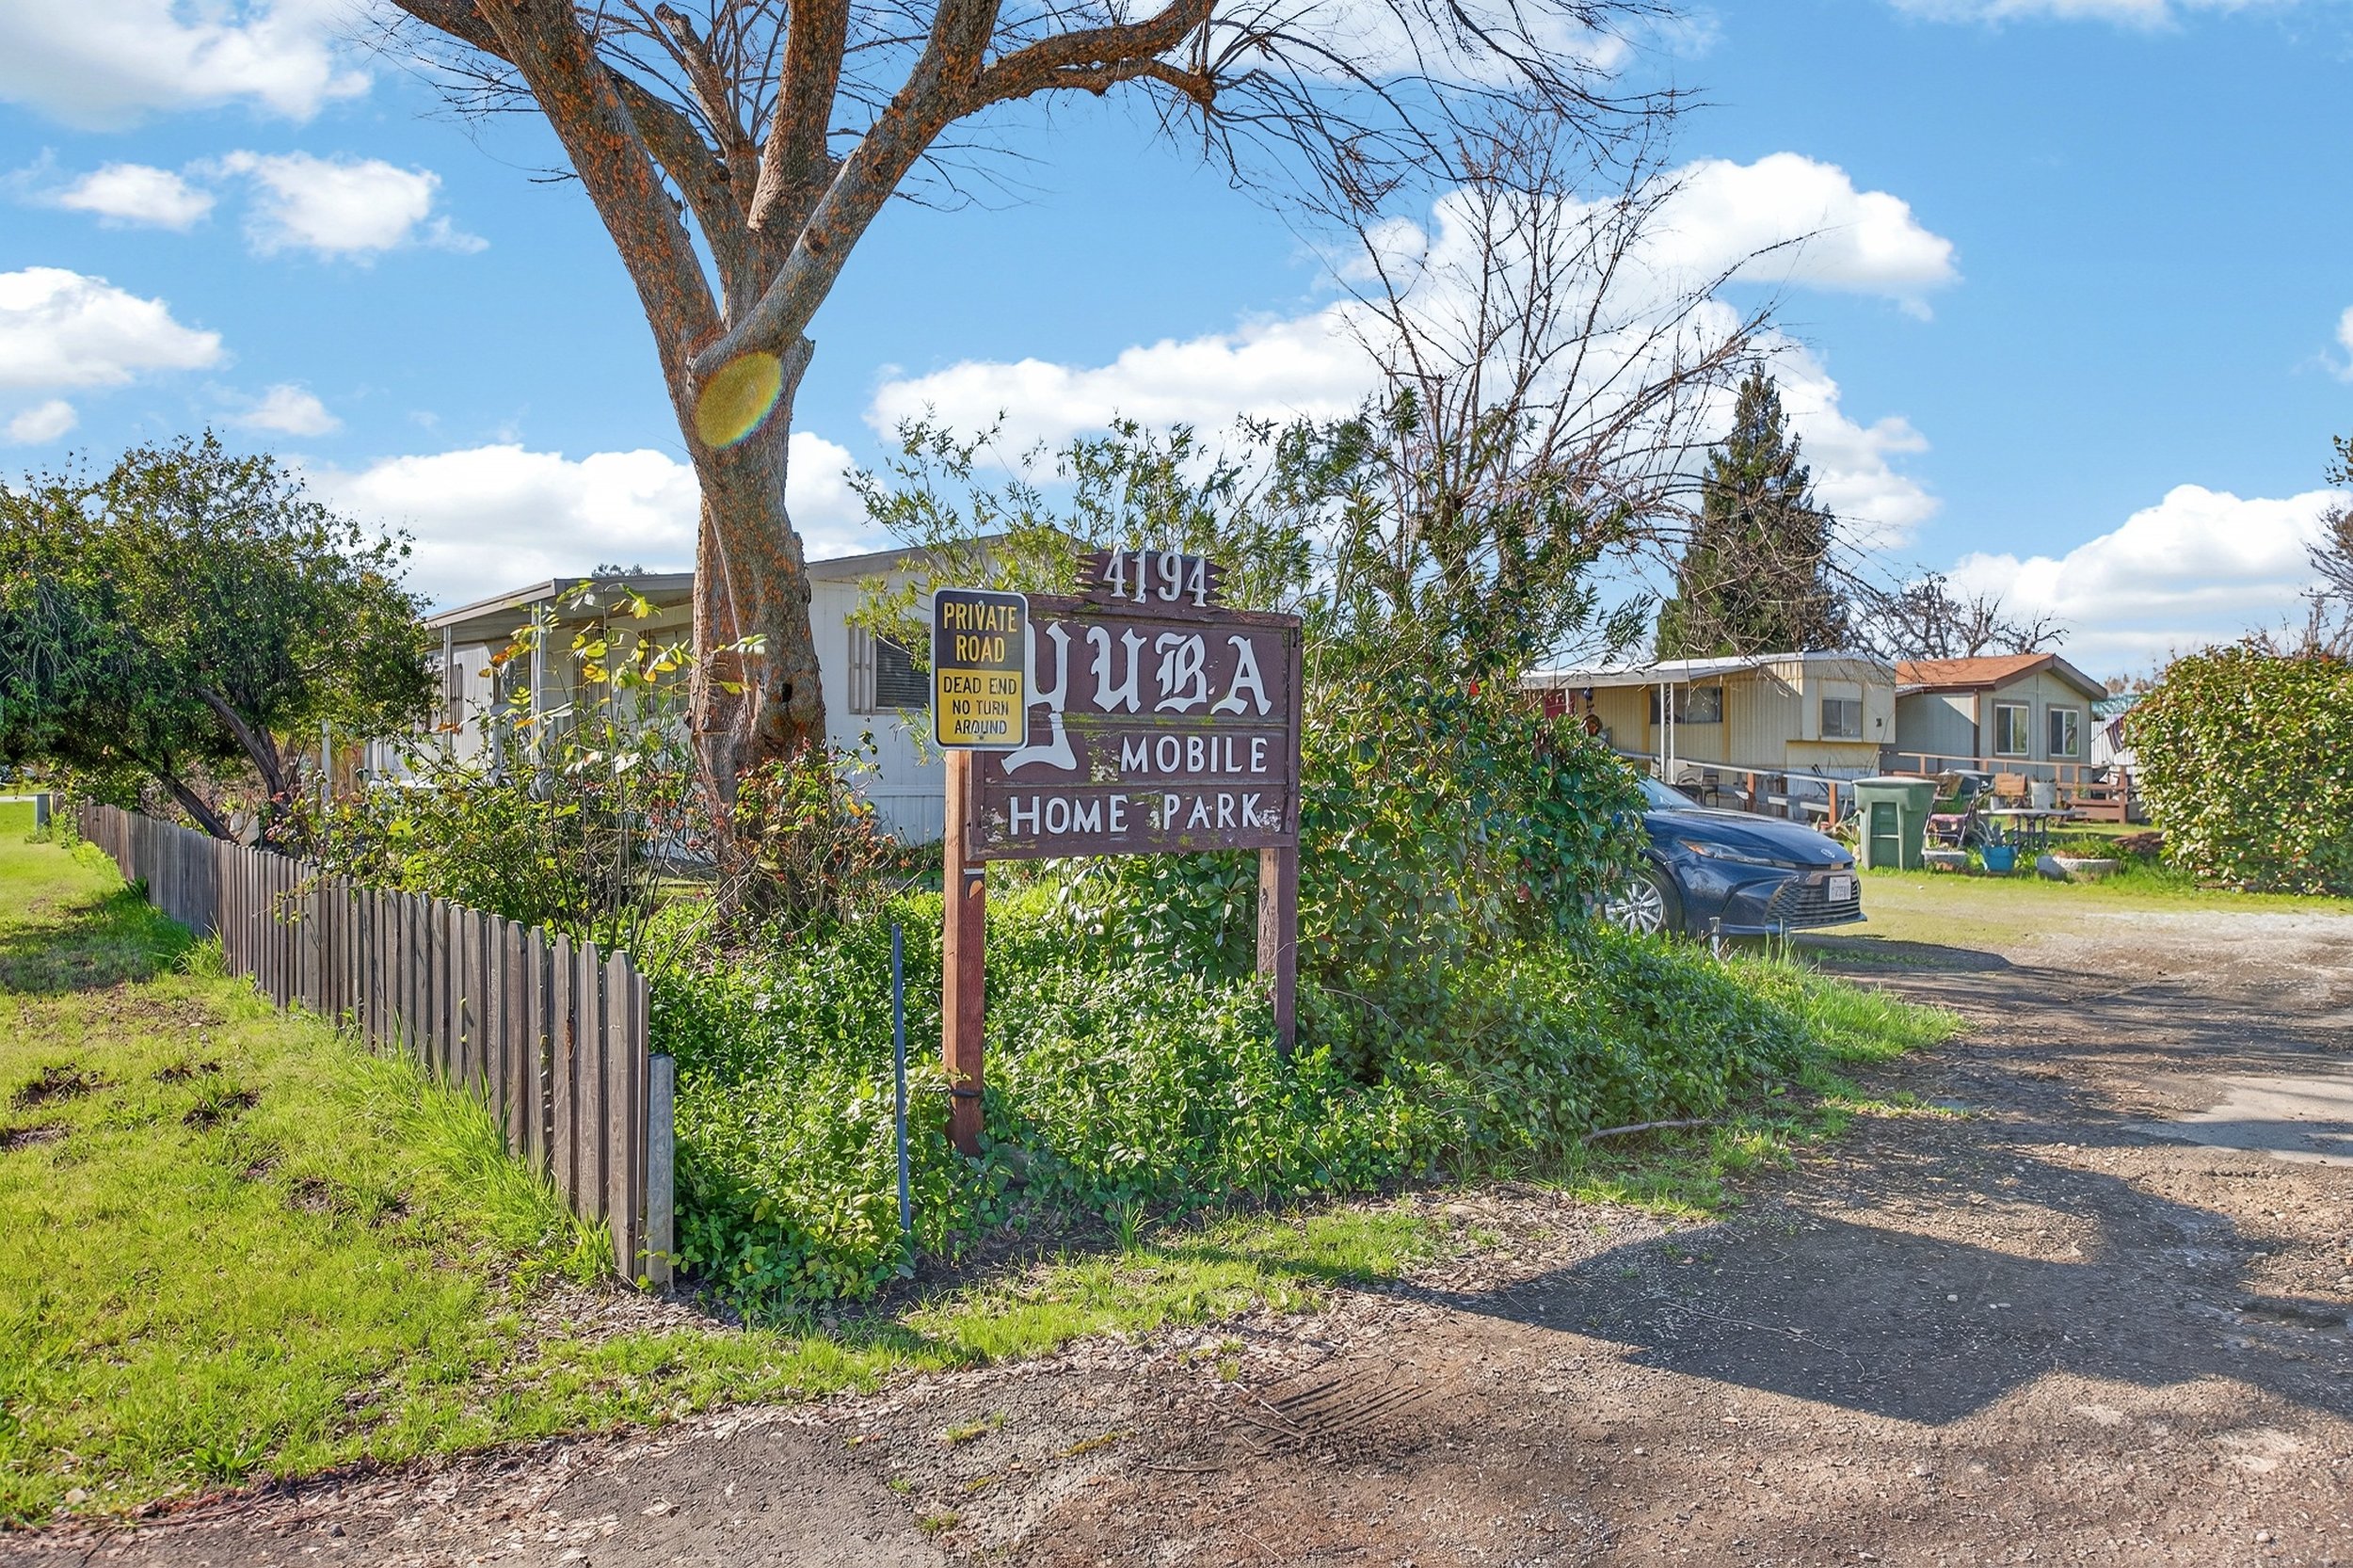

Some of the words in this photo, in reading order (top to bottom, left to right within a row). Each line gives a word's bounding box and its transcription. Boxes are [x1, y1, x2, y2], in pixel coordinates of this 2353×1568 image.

[1102, 545, 1208, 608] 4194
[943, 601, 1017, 633] PRIVATE
[955, 634, 1005, 663] ROAD
[943, 676, 982, 695] DEAD
[989, 677, 1016, 696] END
[1000, 621, 1273, 776] YUBA
[952, 699, 970, 715] NO
[977, 699, 1009, 716] TURN
[954, 719, 1008, 735] AROUND
[1120, 735, 1269, 774] MOBILE
[1010, 793, 1128, 836] HOME
[1162, 792, 1262, 831] PARK
